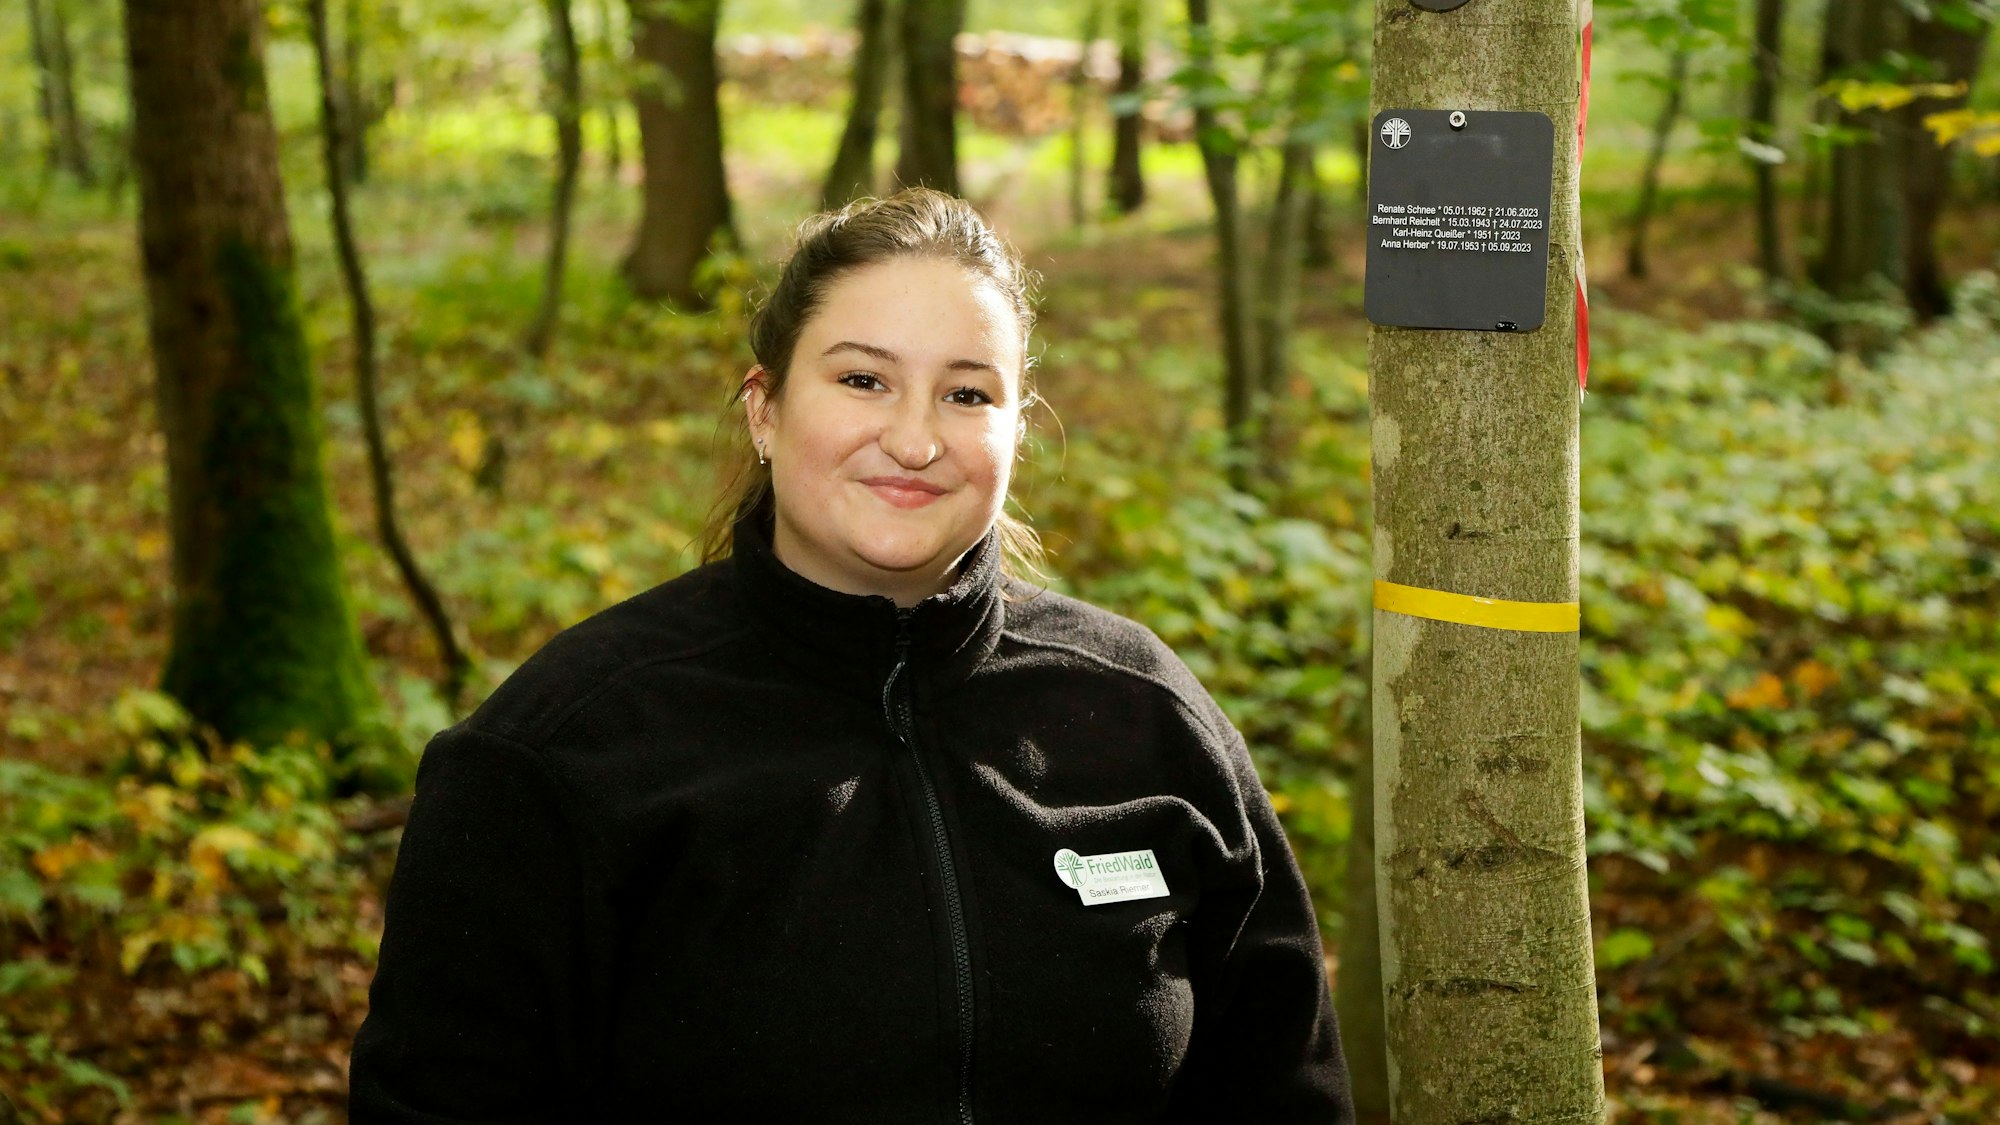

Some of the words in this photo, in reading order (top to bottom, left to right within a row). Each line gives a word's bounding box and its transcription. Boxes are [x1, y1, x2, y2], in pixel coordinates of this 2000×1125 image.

[1378, 204, 1405, 214] Renate
[1407, 205, 1436, 215] Schnee
[1443, 206, 1486, 216] 05.01.1962
[1495, 207, 1538, 217] 21.06.2023
[1372, 216, 1407, 225] Bernhard
[1409, 217, 1440, 226] Reichelt
[1448, 218, 1491, 227] 15.03.1943
[1499, 219, 1543, 229] 24.07.2023
[1392, 228, 1432, 237] Karl-Heinz
[1434, 229, 1465, 239] Queißer
[1474, 230, 1491, 239] 1951
[1501, 231, 1521, 240] 2023
[1381, 239, 1401, 248] Anna
[1403, 240, 1429, 249] Herber
[1437, 242, 1480, 251] 19.07.1953
[1488, 242, 1532, 252] 05.09.2023
[1086, 854, 1153, 875] FriedWald
[1089, 888, 1119, 898] Saskia
